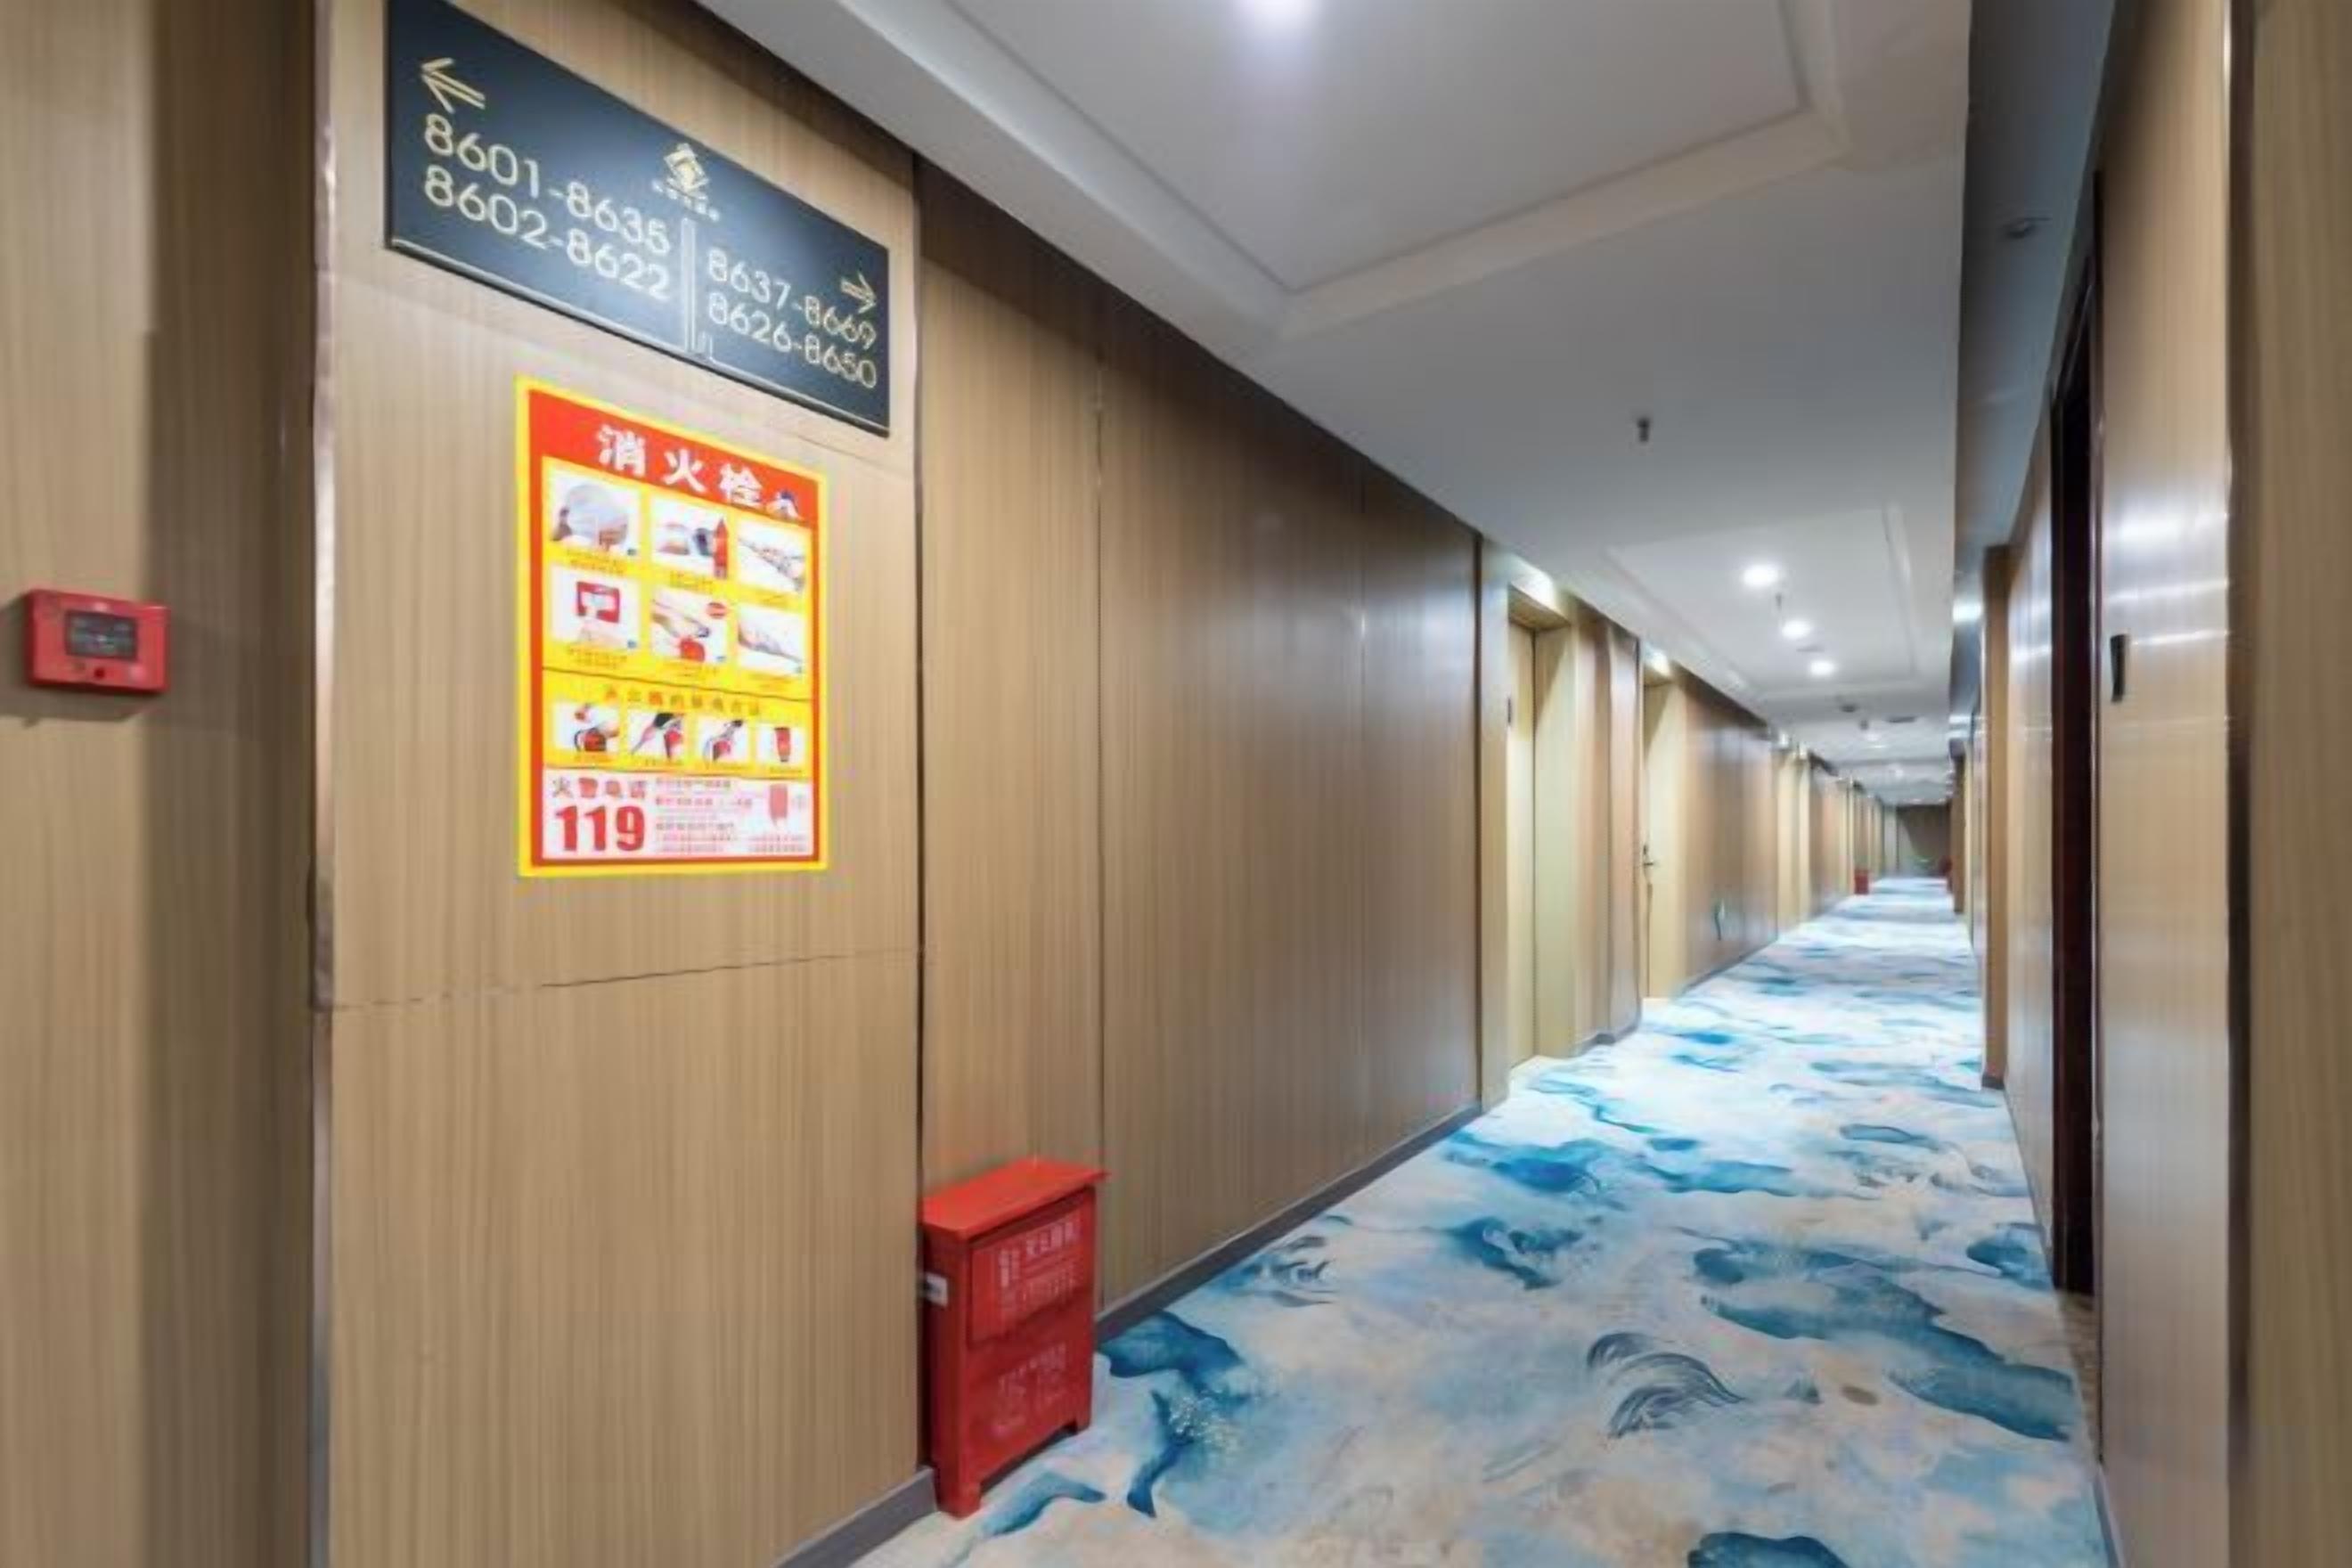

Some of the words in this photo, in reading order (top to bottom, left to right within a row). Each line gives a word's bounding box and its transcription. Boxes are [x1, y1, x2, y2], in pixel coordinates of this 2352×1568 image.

[425, 113, 669, 255] 8601-8635
[425, 165, 669, 301] 8602-8622
[708, 248, 877, 351] 8637-8669
[708, 292, 877, 389] 8626-8650
[596, 423, 763, 508] 消火栓
[555, 804, 646, 853] 119
